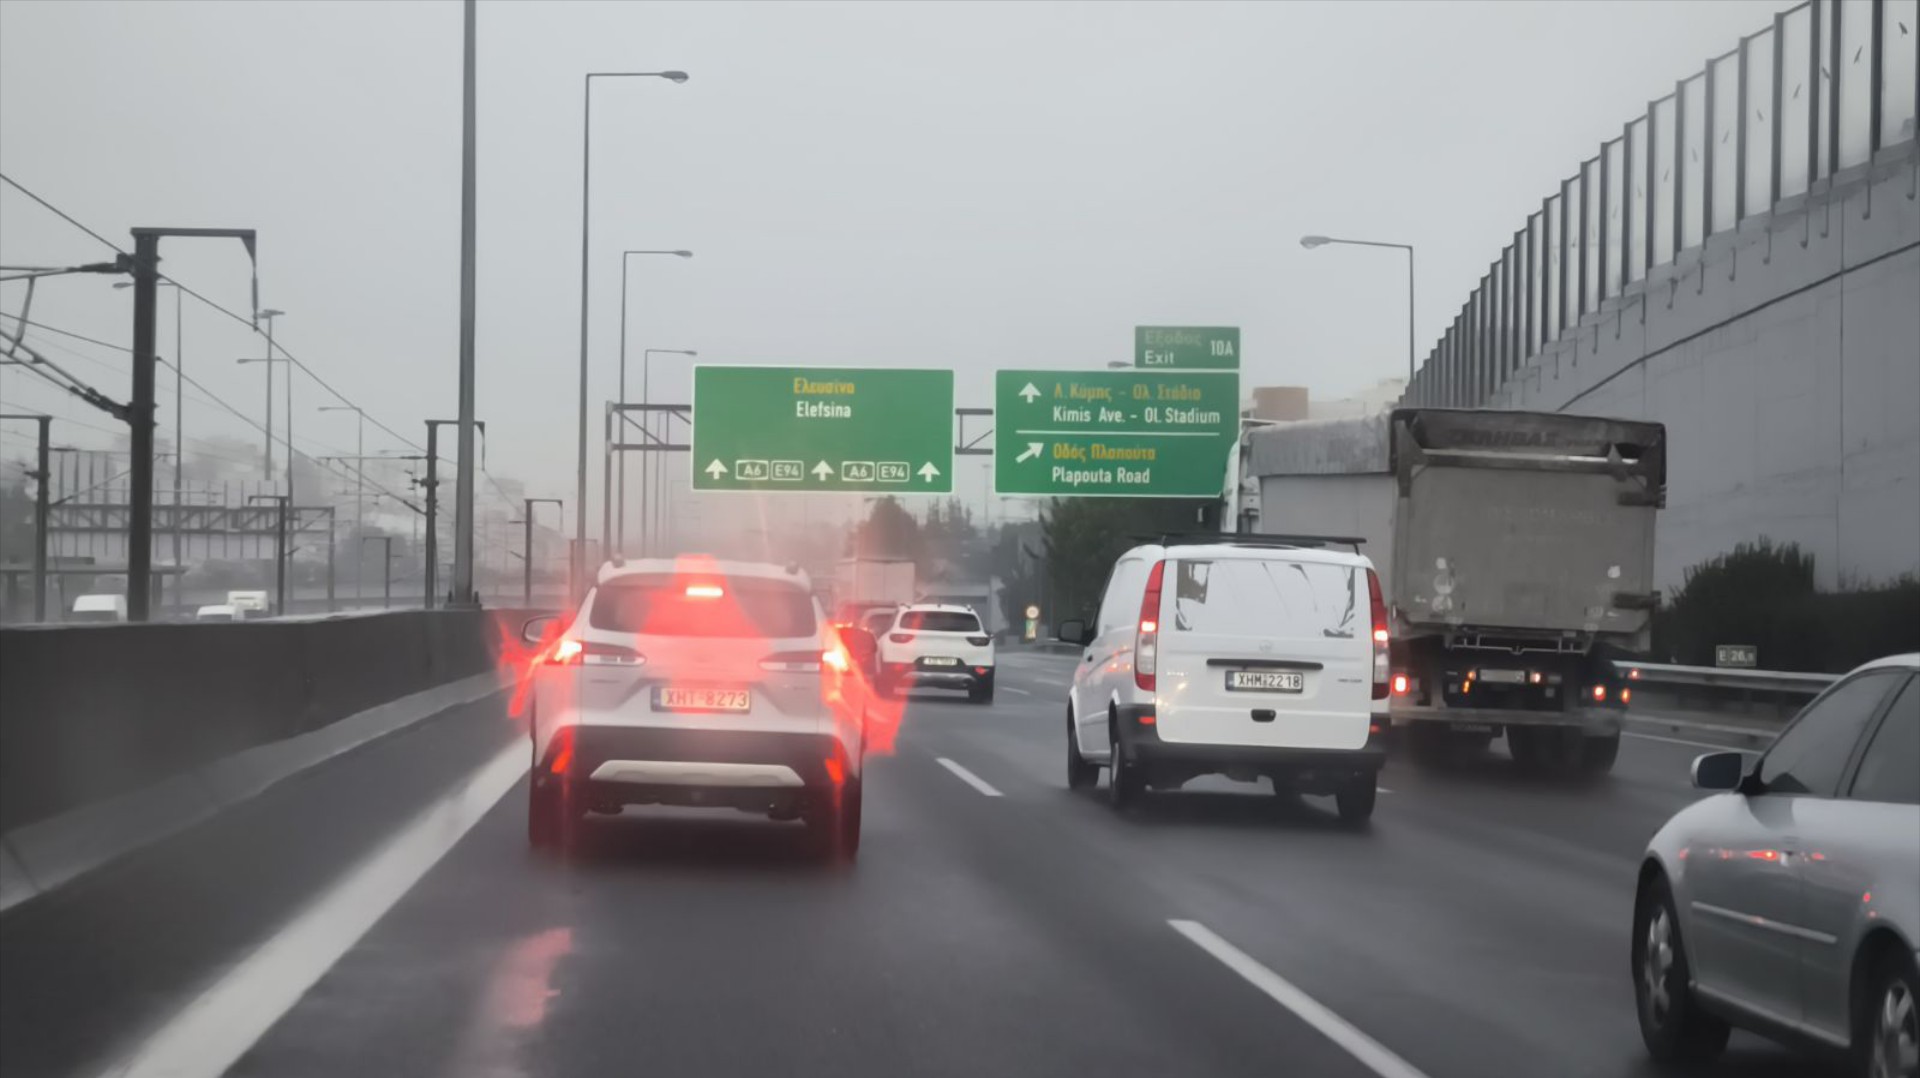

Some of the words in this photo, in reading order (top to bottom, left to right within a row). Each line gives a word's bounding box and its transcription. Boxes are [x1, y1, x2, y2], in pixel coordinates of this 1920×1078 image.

[1210, 340, 1233, 356] 10A
[1145, 350, 1174, 364] Exit
[797, 401, 852, 418] Elefsina
[1053, 406, 1092, 422] Kimis
[1099, 408, 1126, 423] Ave.
[1165, 407, 1221, 424] Stadium
[743, 464, 762, 476] A6
[775, 464, 799, 477] E94
[850, 466, 868, 478] A6
[881, 466, 905, 478] E94
[1052, 466, 1112, 487] Plapouta
[1117, 467, 1150, 484] Road
